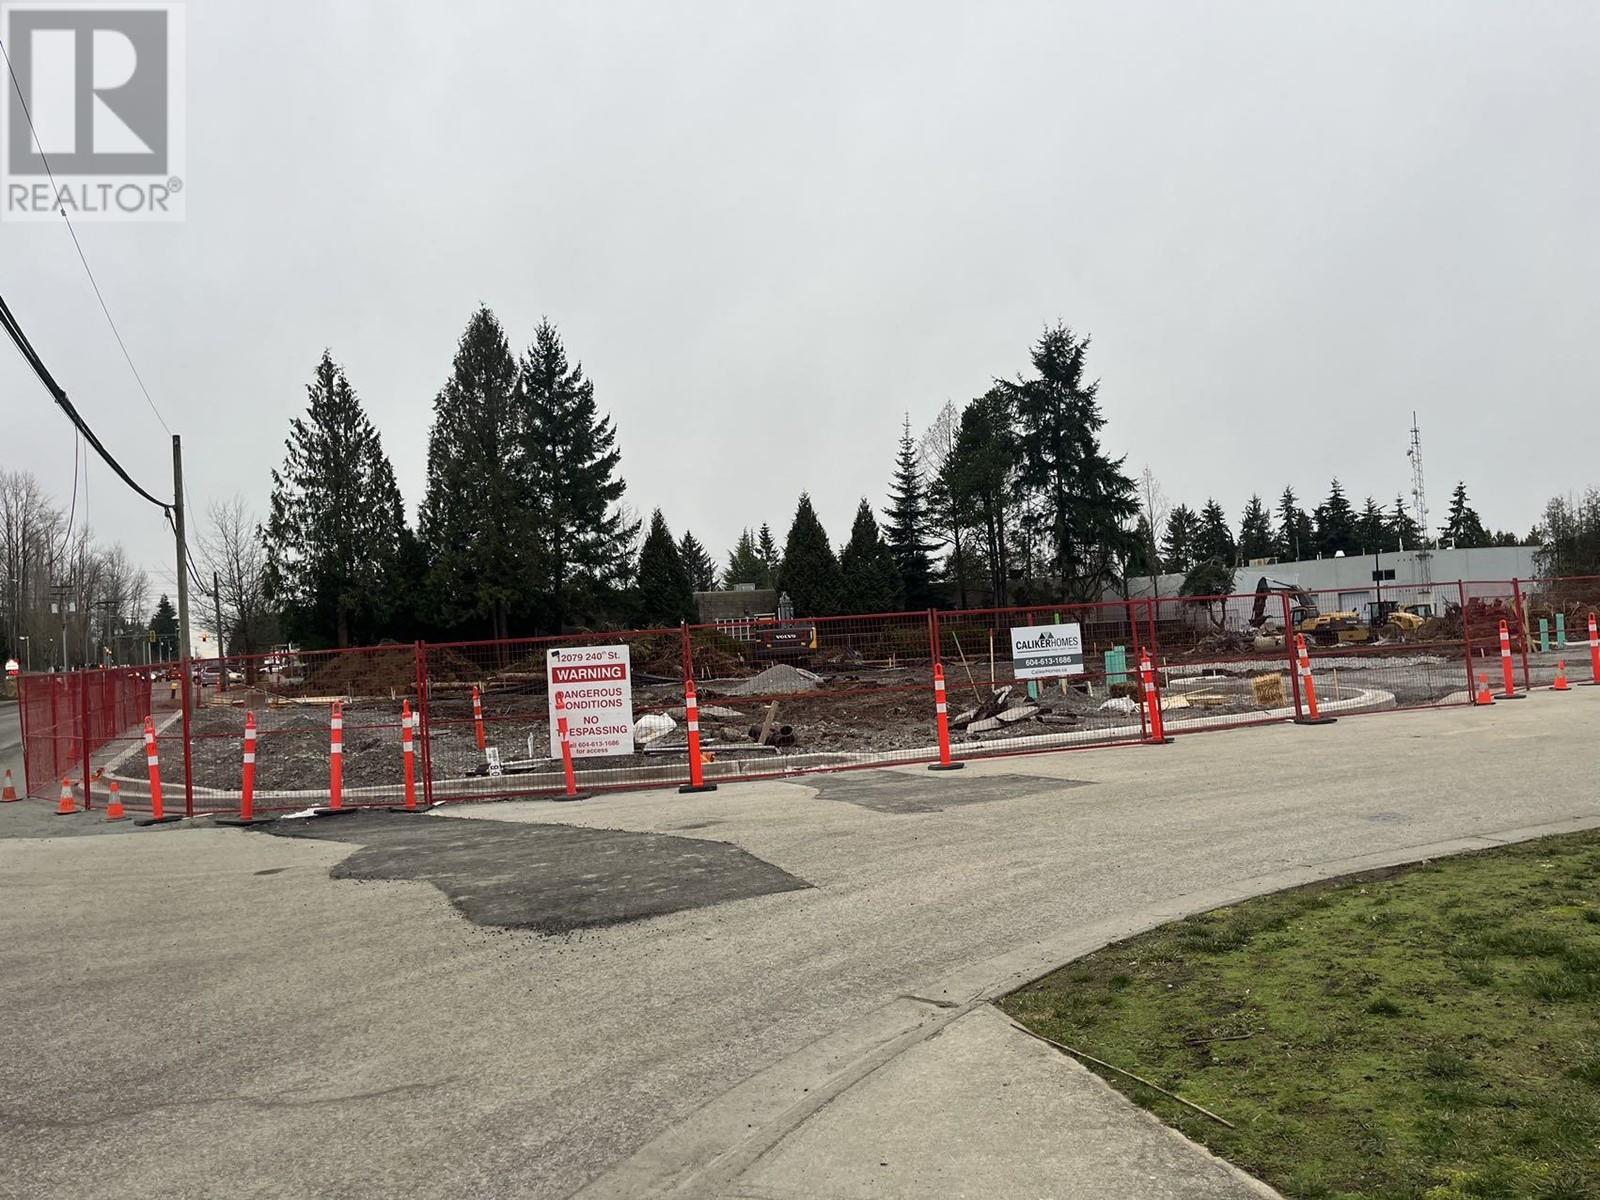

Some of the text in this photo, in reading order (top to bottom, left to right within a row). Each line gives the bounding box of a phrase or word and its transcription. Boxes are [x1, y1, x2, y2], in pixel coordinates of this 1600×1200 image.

[557, 653, 583, 662] 12079
[608, 651, 620, 660] St.
[1025, 656, 1071, 666] 604-613-1686
[557, 667, 621, 680] WARNING
[557, 699, 623, 710] ONDITIONS
[584, 716, 599, 725] NO
